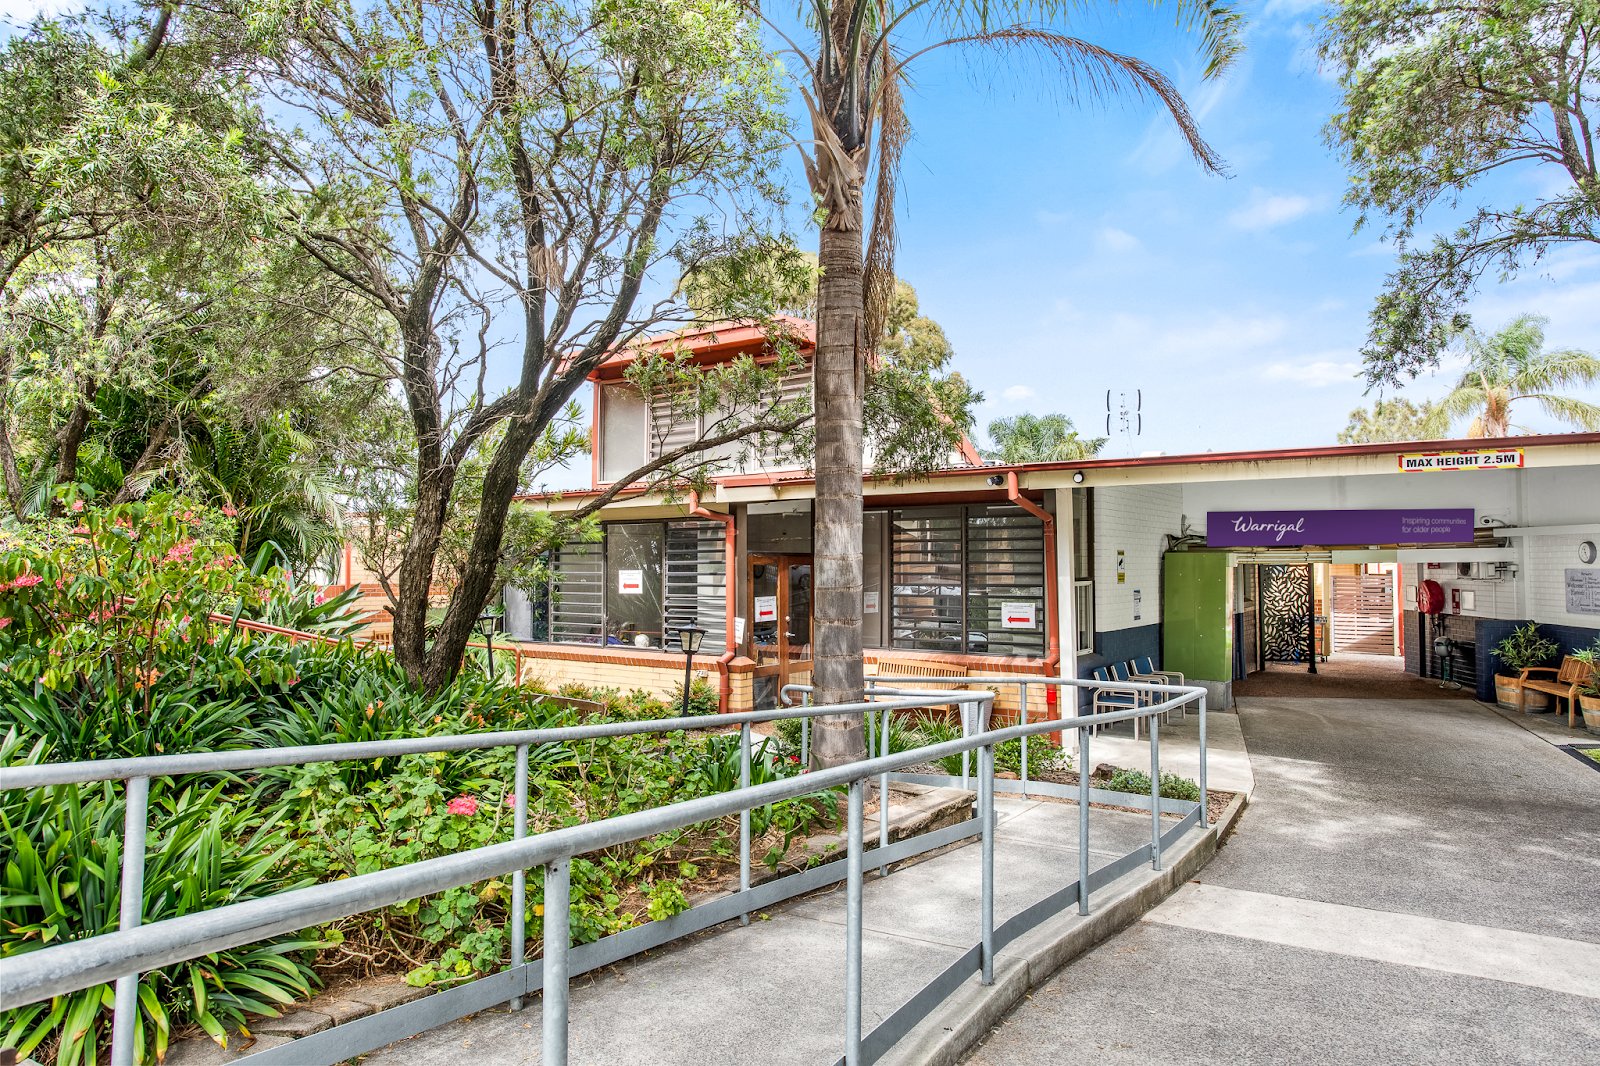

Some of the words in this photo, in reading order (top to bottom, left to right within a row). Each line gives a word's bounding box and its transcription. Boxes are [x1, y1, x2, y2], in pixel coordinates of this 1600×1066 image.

[1406, 458, 1433, 468] MAX
[1437, 456, 1480, 466] HEIGHT
[1483, 454, 1516, 464] 2.5M
[1401, 517, 1431, 526] Inspiring
[1231, 516, 1305, 542] Warrigal
[1401, 525, 1411, 533] for
[1430, 526, 1451, 534] people
